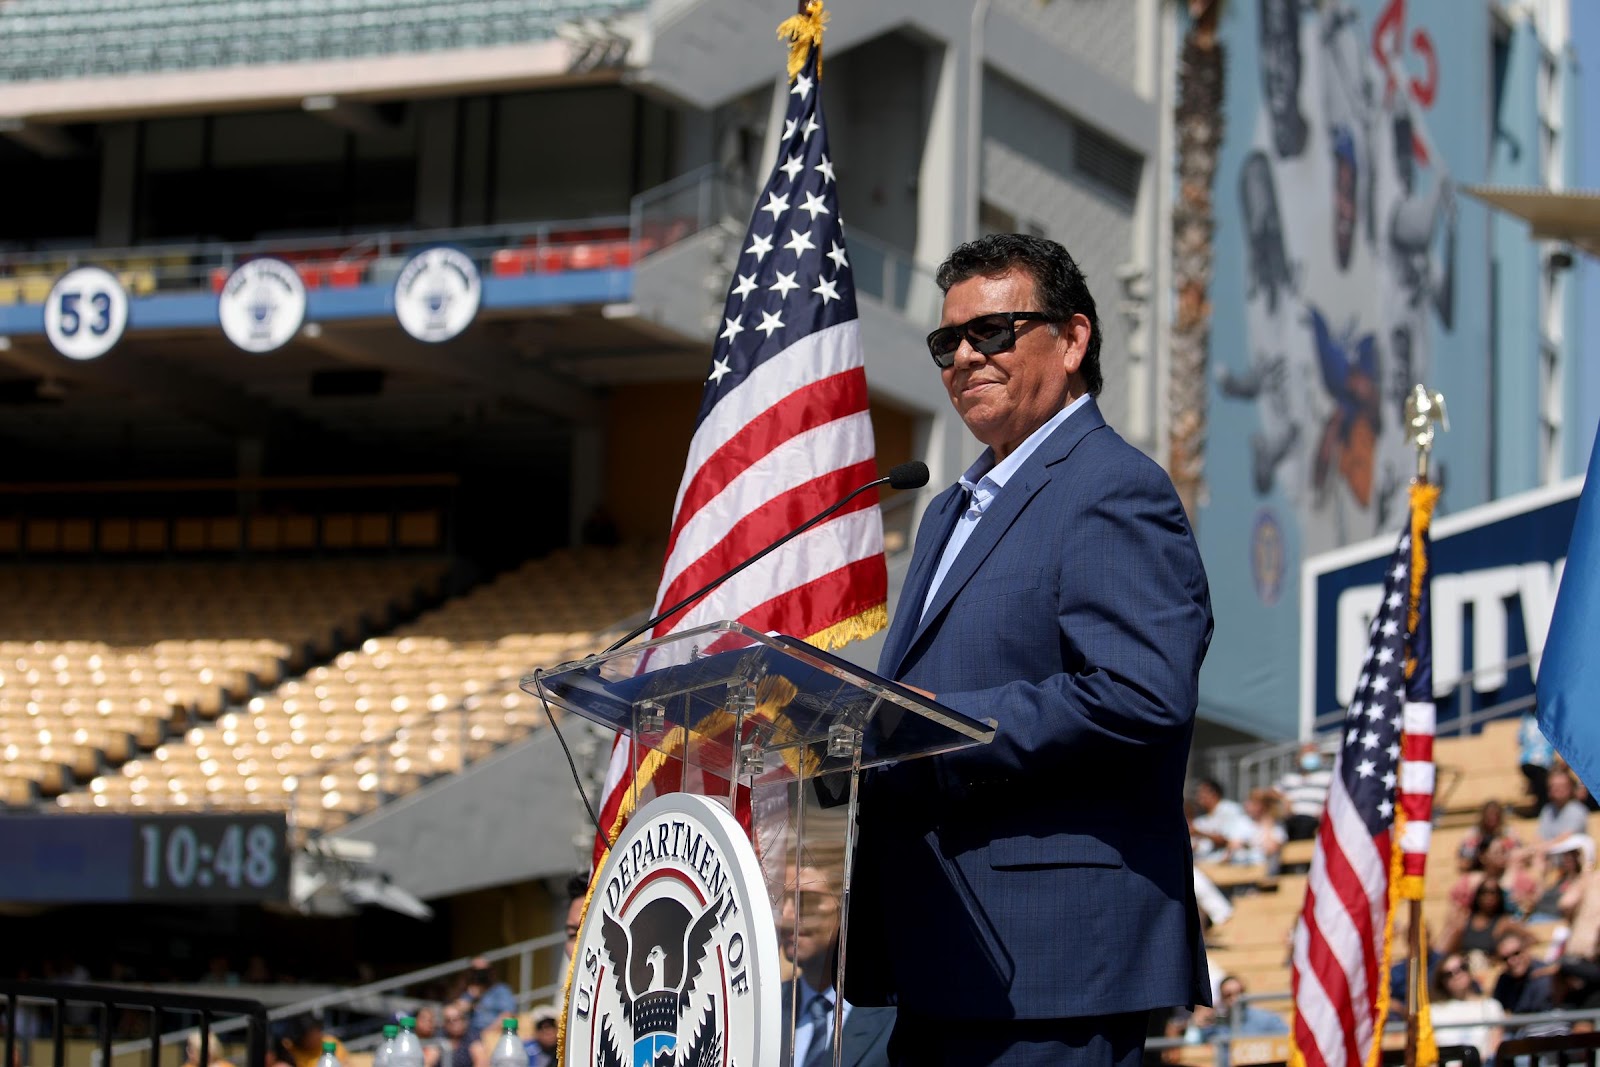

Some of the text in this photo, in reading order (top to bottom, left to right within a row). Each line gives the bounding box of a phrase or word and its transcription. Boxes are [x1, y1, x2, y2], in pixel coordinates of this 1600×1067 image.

[60, 292, 111, 337] 53
[140, 824, 277, 888] 10:48
[576, 820, 749, 1019] U.S. DEPARTMENT OF
